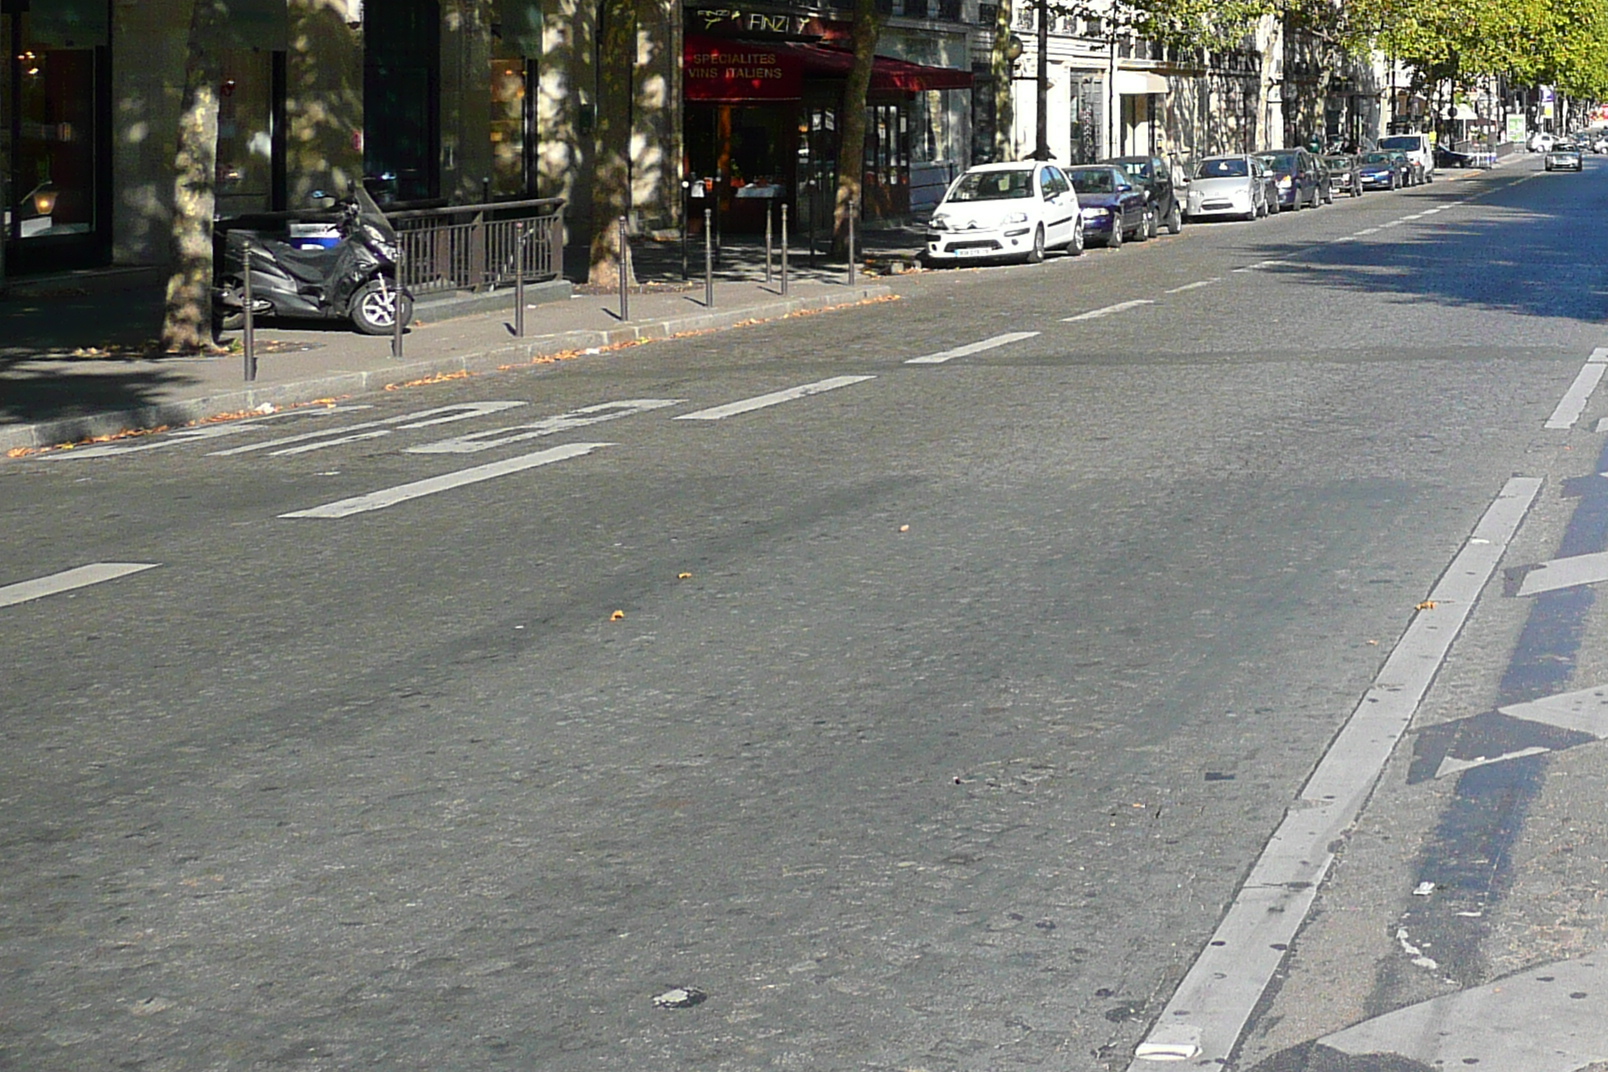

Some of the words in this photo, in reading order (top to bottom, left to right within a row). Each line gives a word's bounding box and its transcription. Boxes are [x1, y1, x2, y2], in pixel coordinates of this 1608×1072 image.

[747, 12, 790, 34] FINZI
[689, 67, 719, 79] VINS
[725, 67, 783, 80] ITALIENS
[35, 398, 690, 460] BUS
